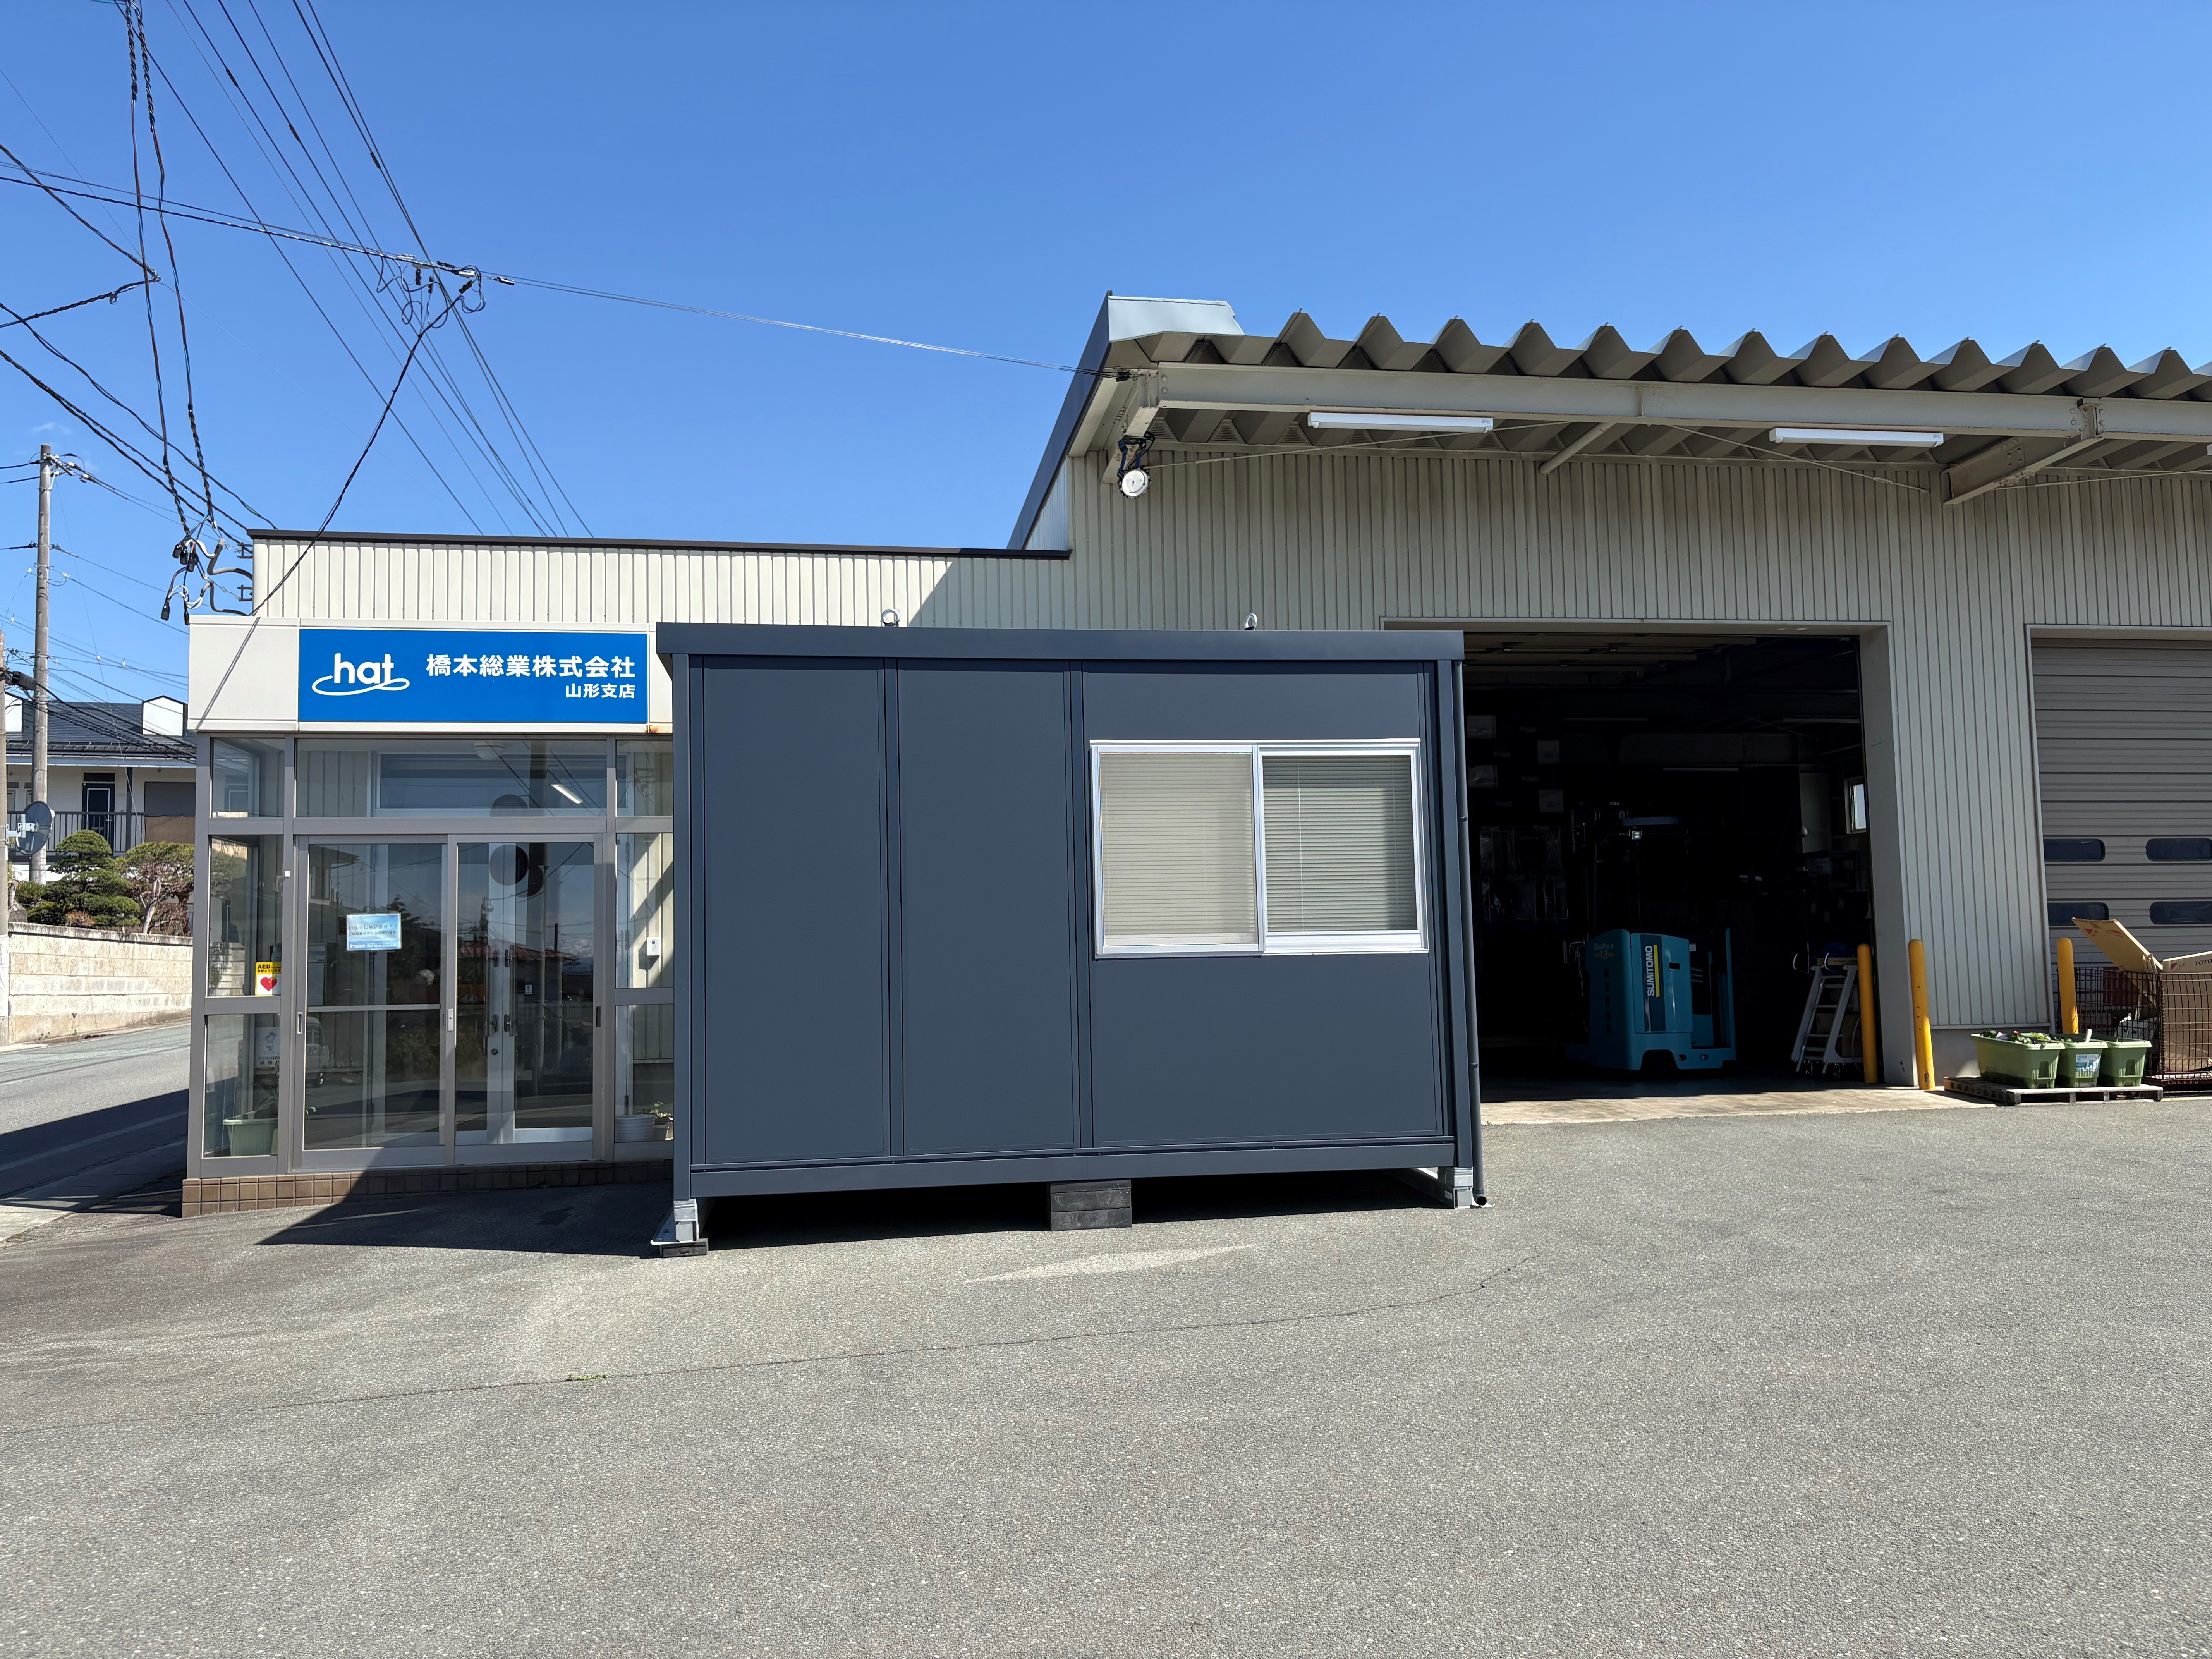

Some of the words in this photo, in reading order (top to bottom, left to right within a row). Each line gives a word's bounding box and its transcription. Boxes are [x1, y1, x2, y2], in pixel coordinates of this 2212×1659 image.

[426, 654, 635, 678] 橋本総業株式会社
[566, 683, 635, 699] 山形支店
[1599, 950, 1608, 960] 13
[1645, 946, 1655, 996] SUMITOMO
